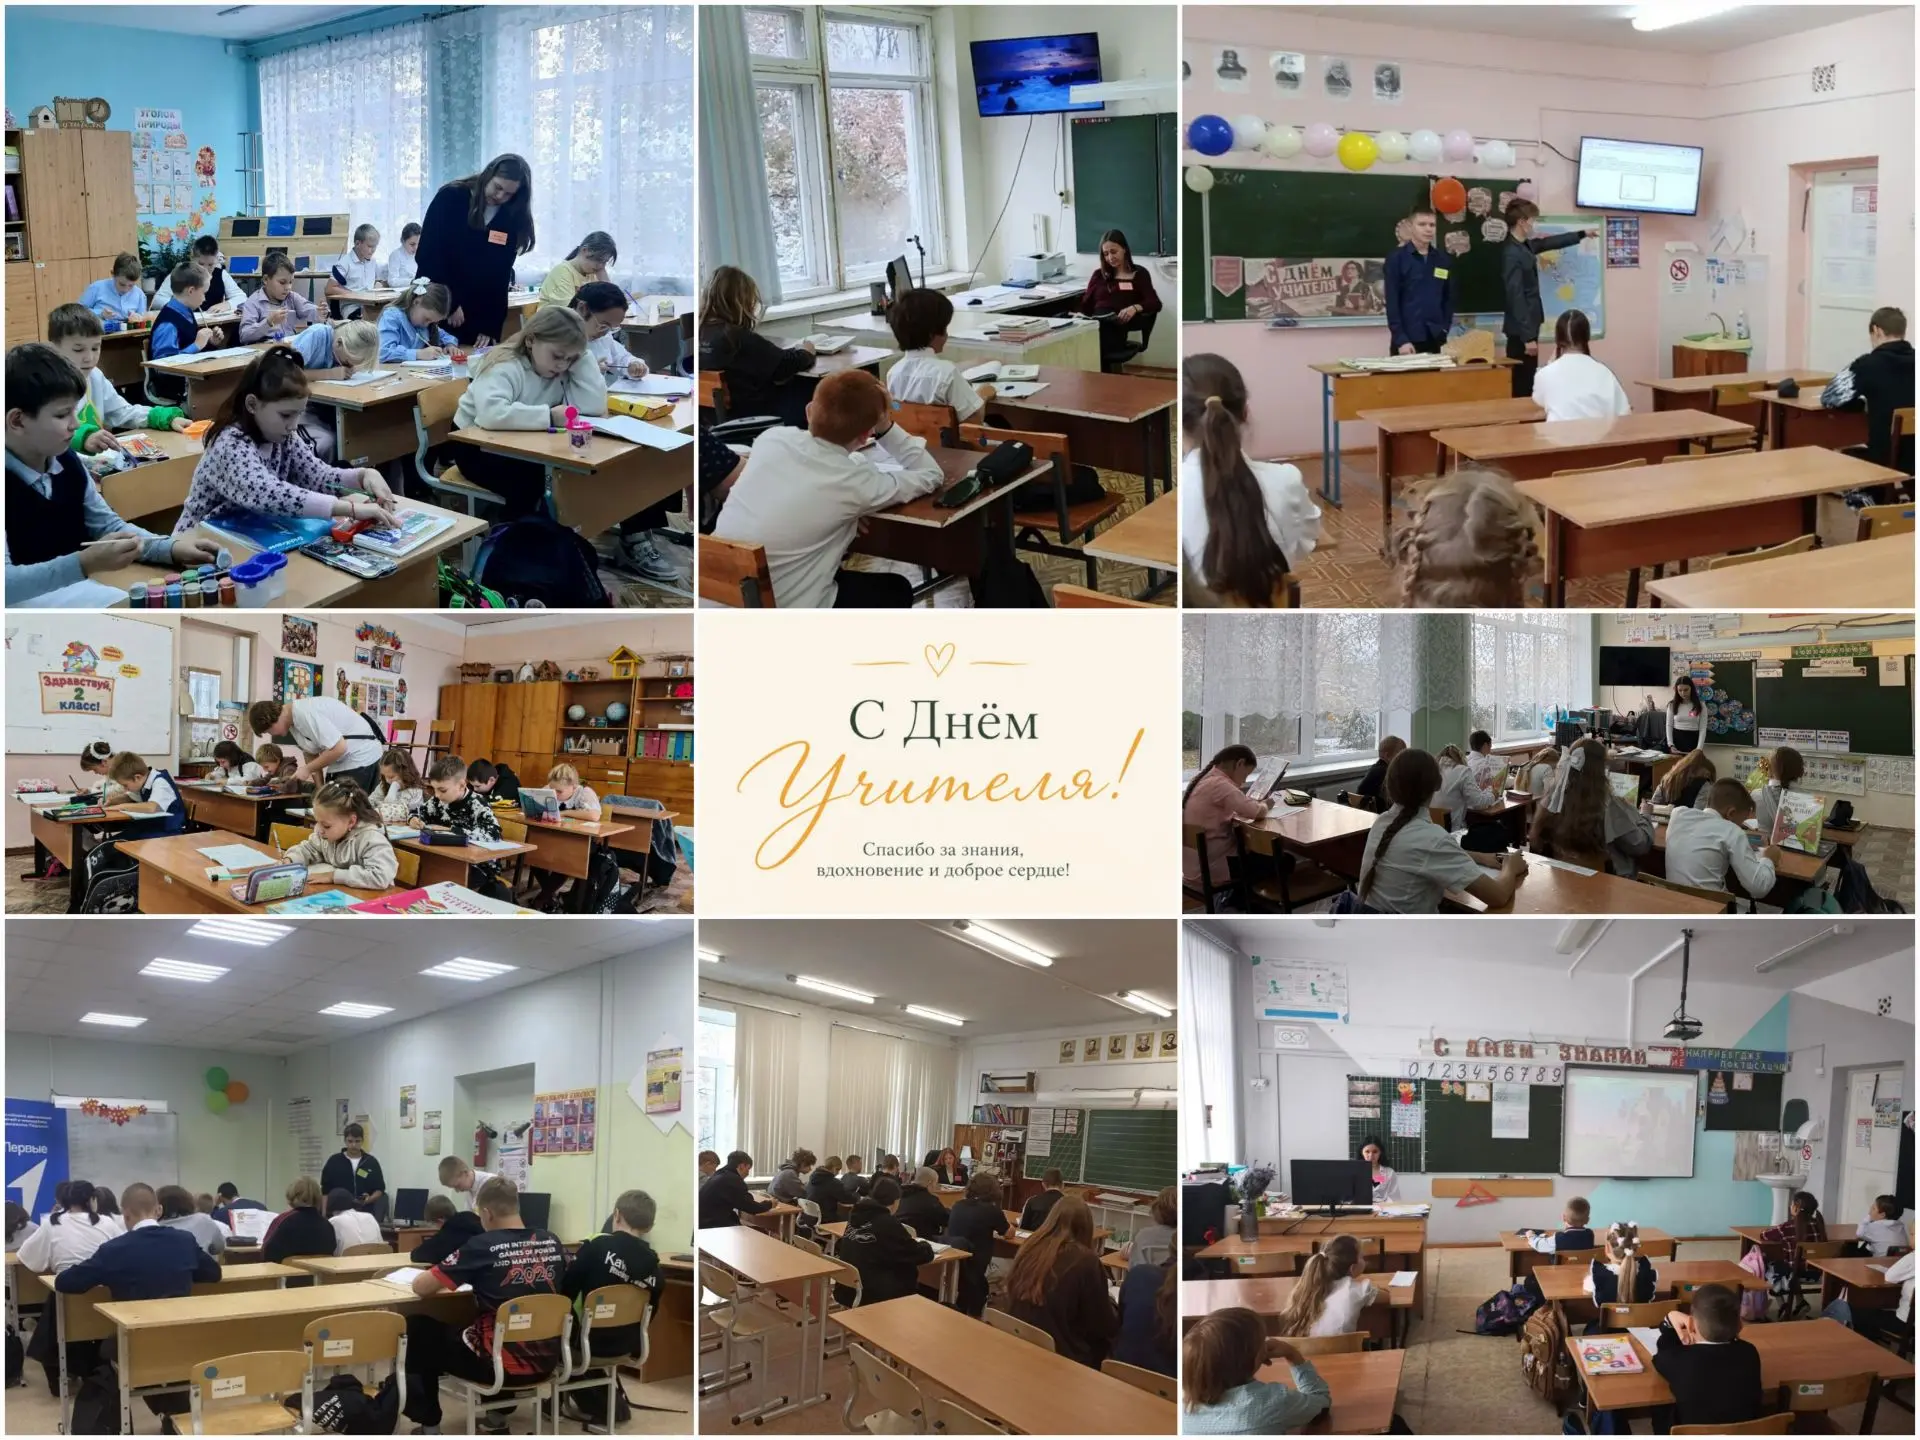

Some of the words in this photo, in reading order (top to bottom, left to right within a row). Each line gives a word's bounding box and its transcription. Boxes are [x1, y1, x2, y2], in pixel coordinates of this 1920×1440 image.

[140, 109, 176, 119] УГОЛОК
[137, 120, 181, 130] ПРИРОДЫ
[1265, 264, 1278, 284] С
[1283, 262, 1333, 282] ДНЁМ
[1272, 279, 1337, 299] УЧИТЕЛЯ
[43, 675, 112, 692] Здравствуй,
[74, 687, 85, 700] 2
[59, 701, 100, 712] класс!
[1434, 1037, 1449, 1057] С
[1558, 1043, 1648, 1065] ЗНАНИЙ
[489, 1243, 510, 1252] OPEN
[498, 1250, 524, 1259] GAMES
[493, 1259, 510, 1268] AND
[512, 1257, 541, 1265] MARTIAL
